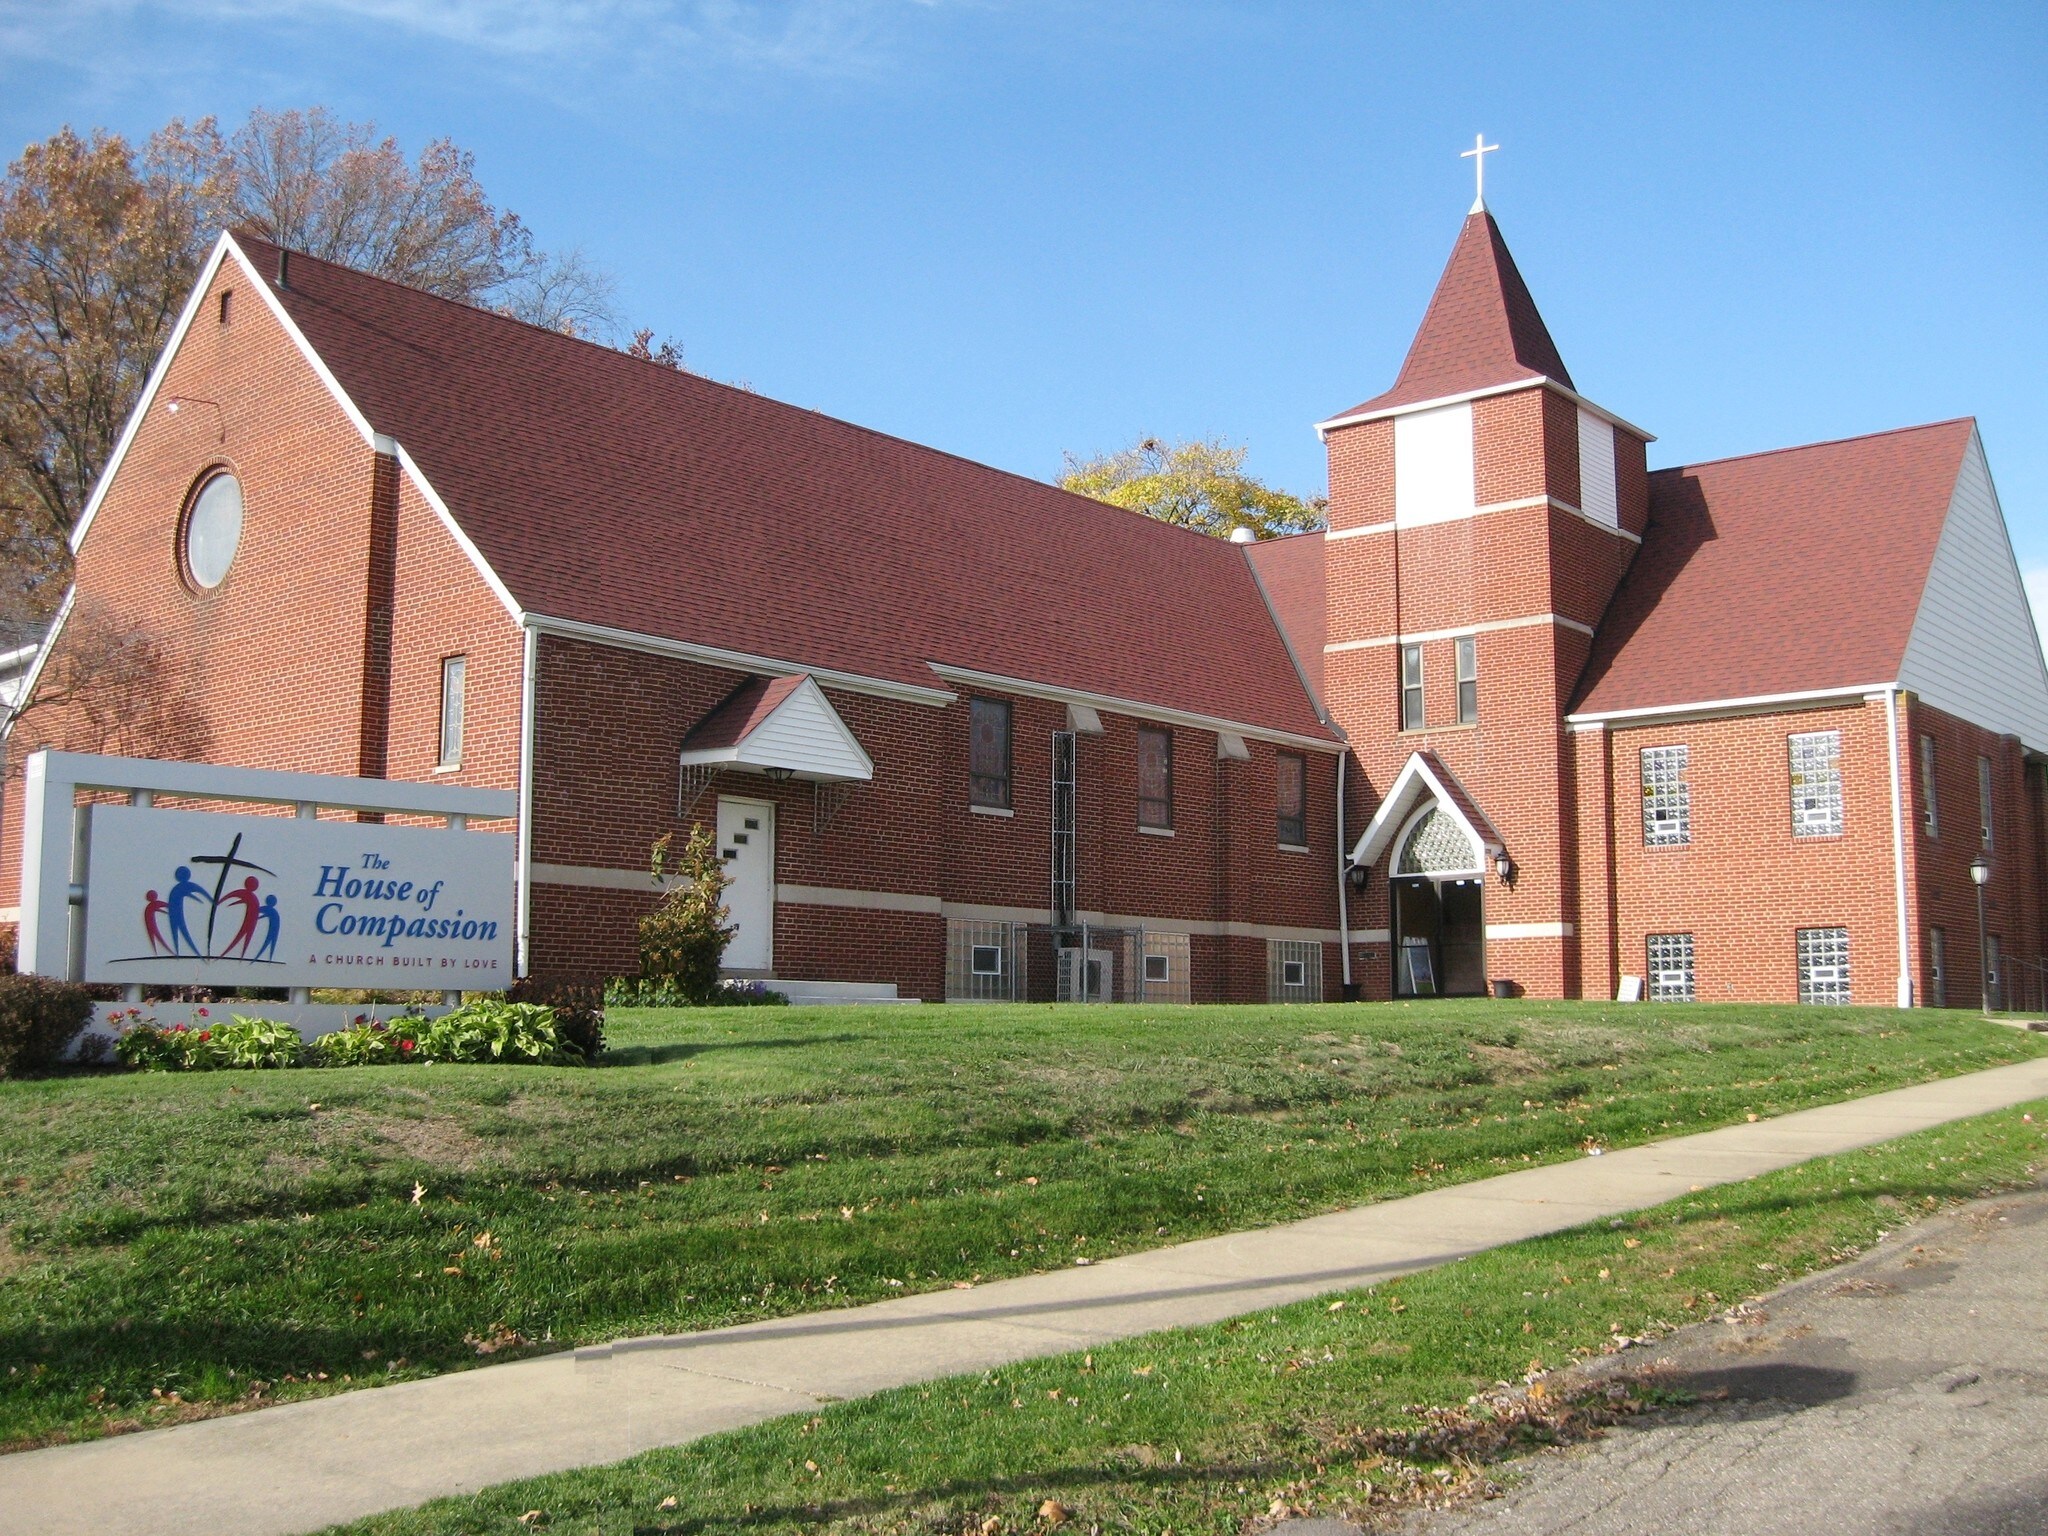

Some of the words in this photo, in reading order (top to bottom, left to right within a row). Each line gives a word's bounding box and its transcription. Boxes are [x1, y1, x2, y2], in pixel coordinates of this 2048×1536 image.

[361, 853, 390, 870] The
[313, 865, 413, 900] House
[416, 880, 444, 911] of
[316, 902, 498, 947] Compassion
[309, 954, 317, 964] A
[325, 954, 384, 966] CHURCH
[393, 956, 433, 967] BUILT
[440, 957, 457, 968] BY
[465, 958, 498, 969] LOVE
